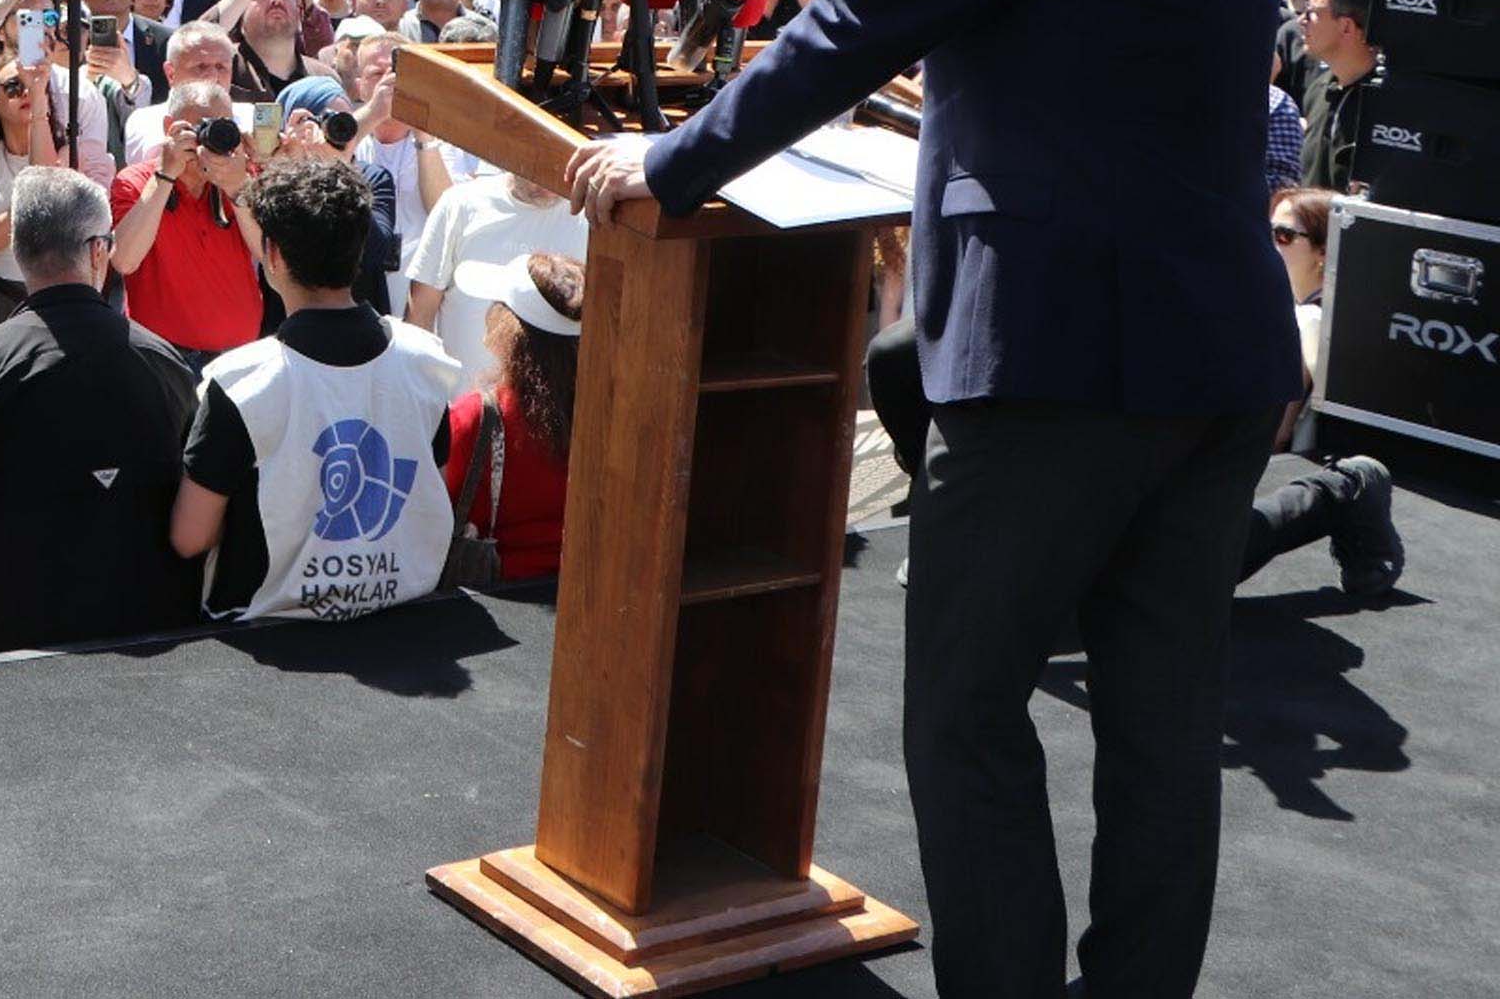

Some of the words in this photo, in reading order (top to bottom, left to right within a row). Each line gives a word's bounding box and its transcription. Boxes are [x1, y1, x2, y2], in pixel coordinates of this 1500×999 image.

[1372, 124, 1422, 146] ROX
[1389, 312, 1499, 364] ROX
[303, 551, 401, 578] SOSYAL
[301, 579, 399, 604] HAKLAR
